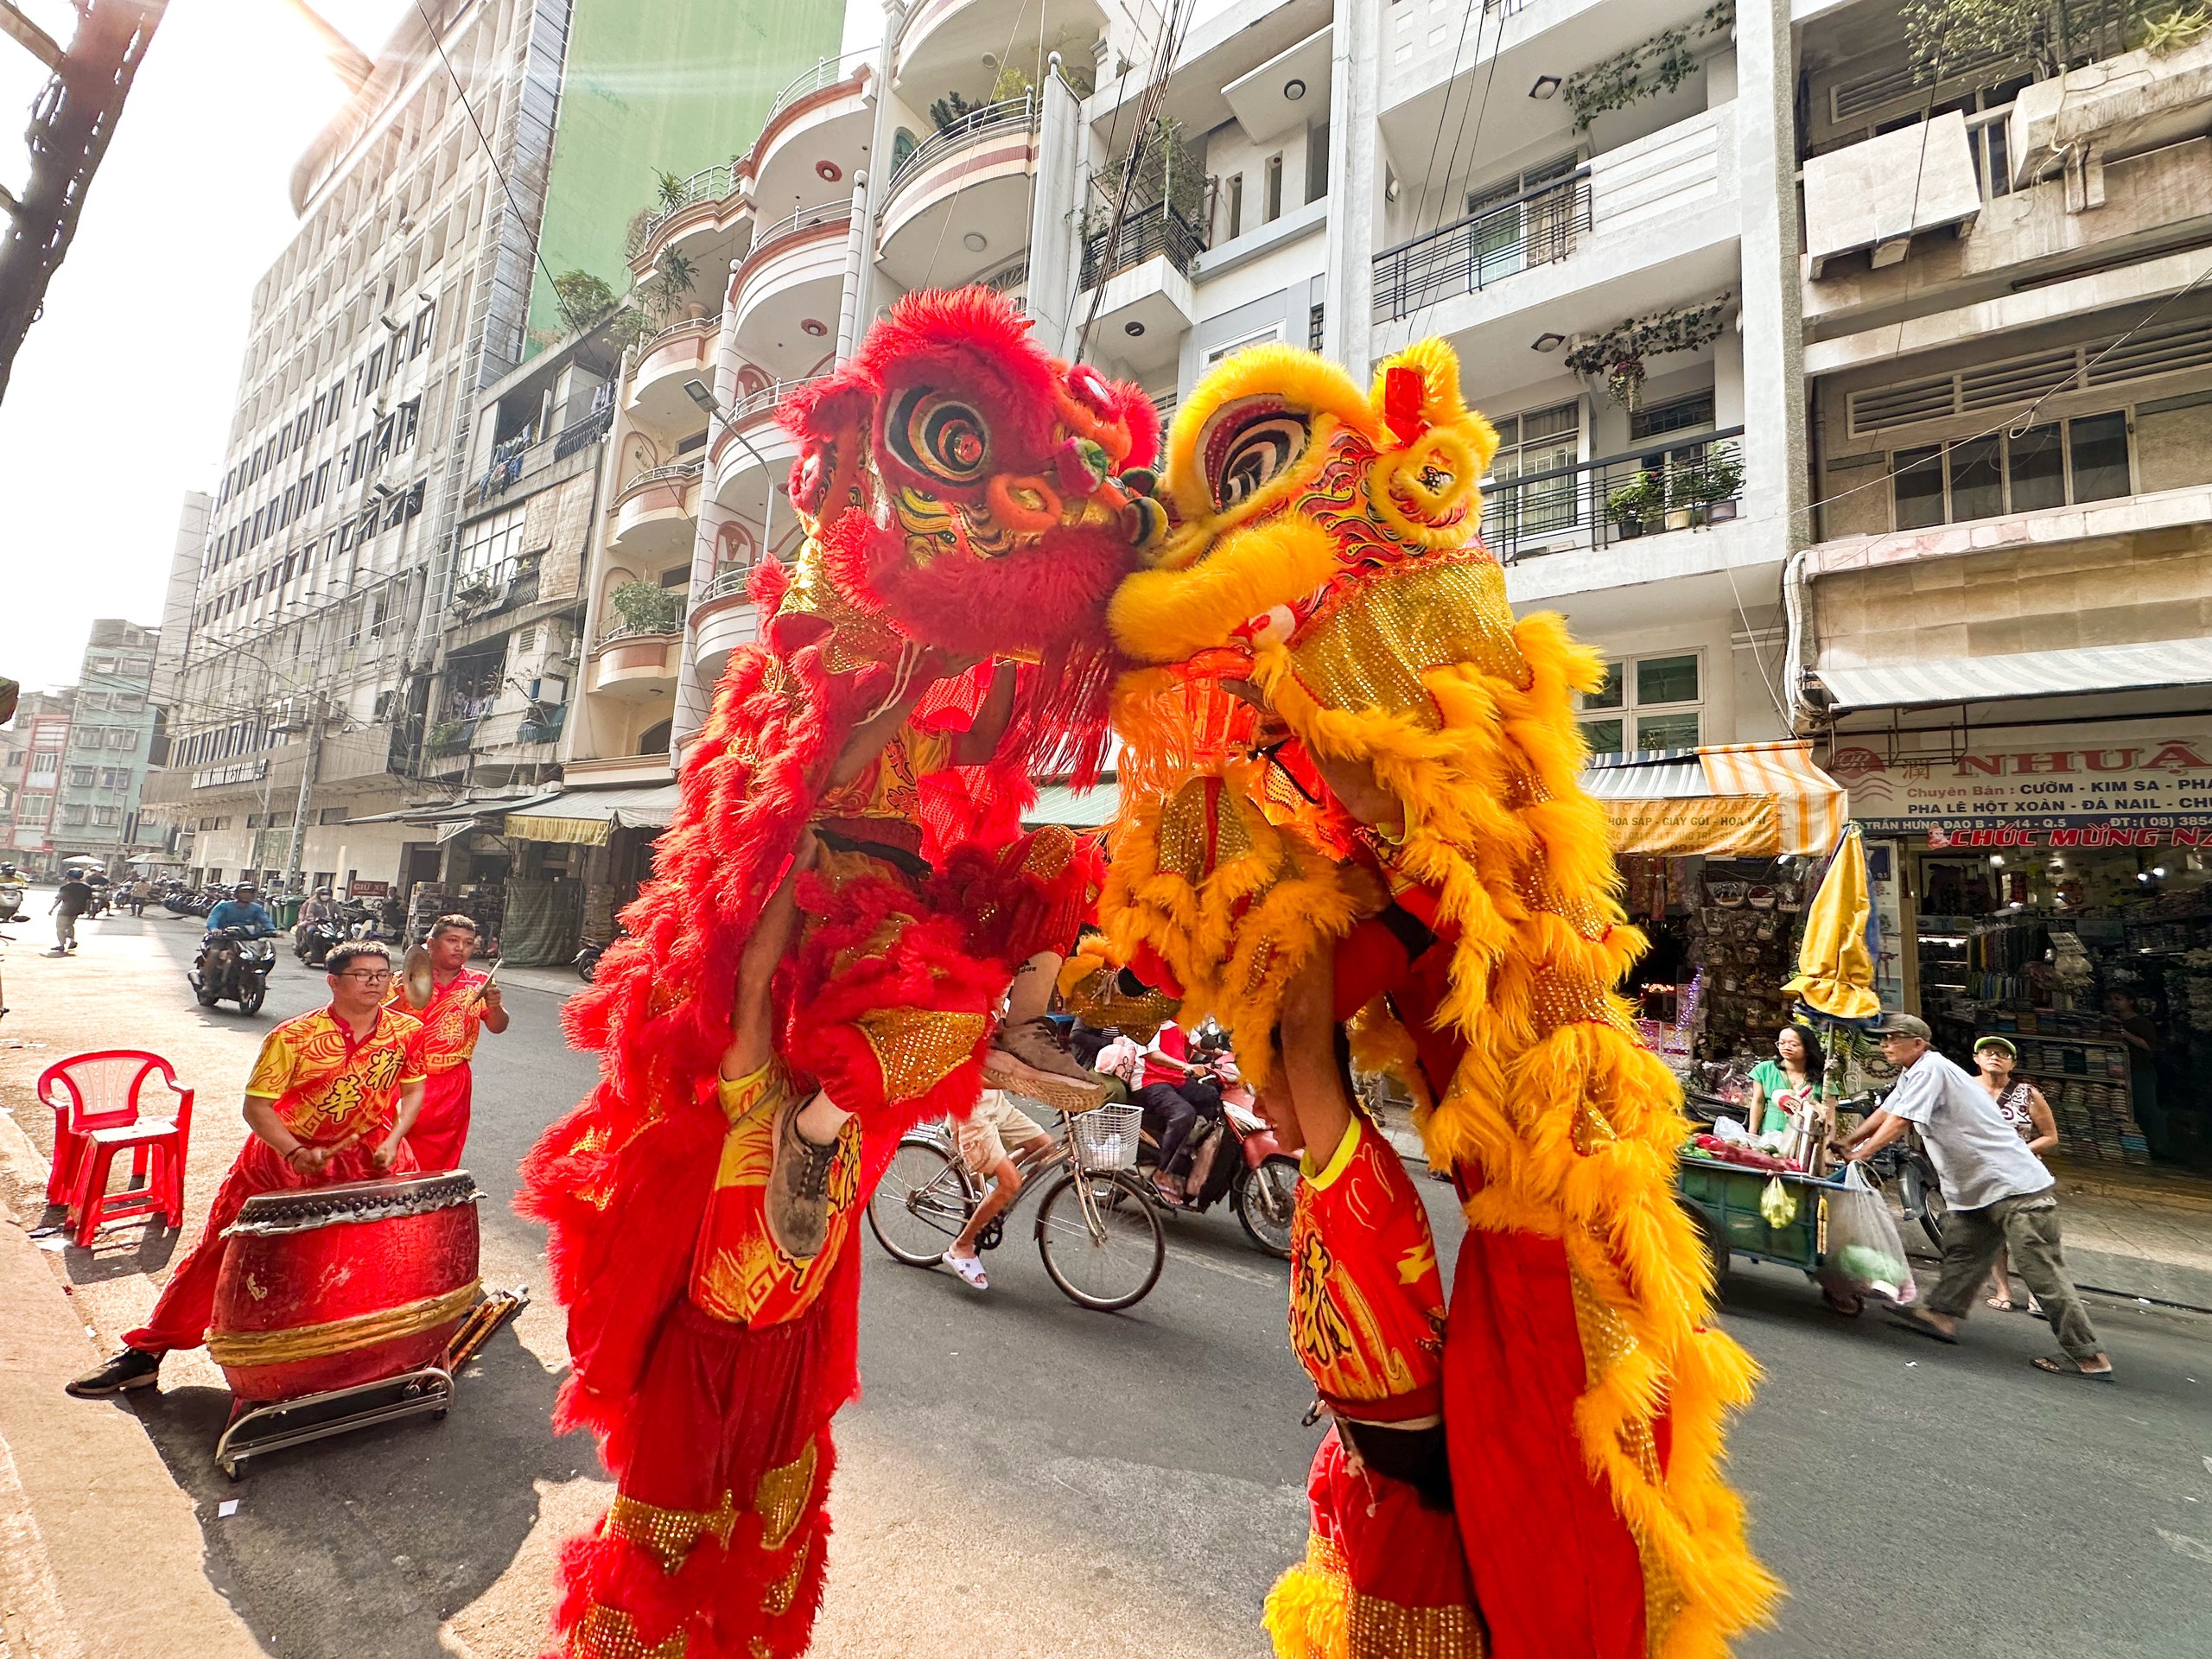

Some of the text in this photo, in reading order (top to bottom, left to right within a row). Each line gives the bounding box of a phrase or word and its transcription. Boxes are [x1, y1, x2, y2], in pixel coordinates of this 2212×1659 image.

[1907, 787, 1967, 798] Chuyên
[1973, 785, 2005, 796] Bán
[2091, 781, 2127, 792] KIM
[2133, 780, 2159, 791] SA
[1908, 804, 1941, 814] PHA
[1947, 801, 1967, 813] LÊ
[1973, 800, 2008, 815] HỘT
[2014, 798, 2065, 812] XOÀN
[2082, 797, 2108, 810] ĐÁ
[2114, 798, 2161, 810] NAIL
[2179, 798, 2212, 809] CH
[1720, 817, 1744, 825] HOA
[1975, 820, 1984, 829] B
[2014, 819, 2030, 828] 14
[2043, 818, 2067, 828] Q.5
[1950, 823, 2039, 847] CHÚC
[2049, 823, 2159, 847] MỪNG
